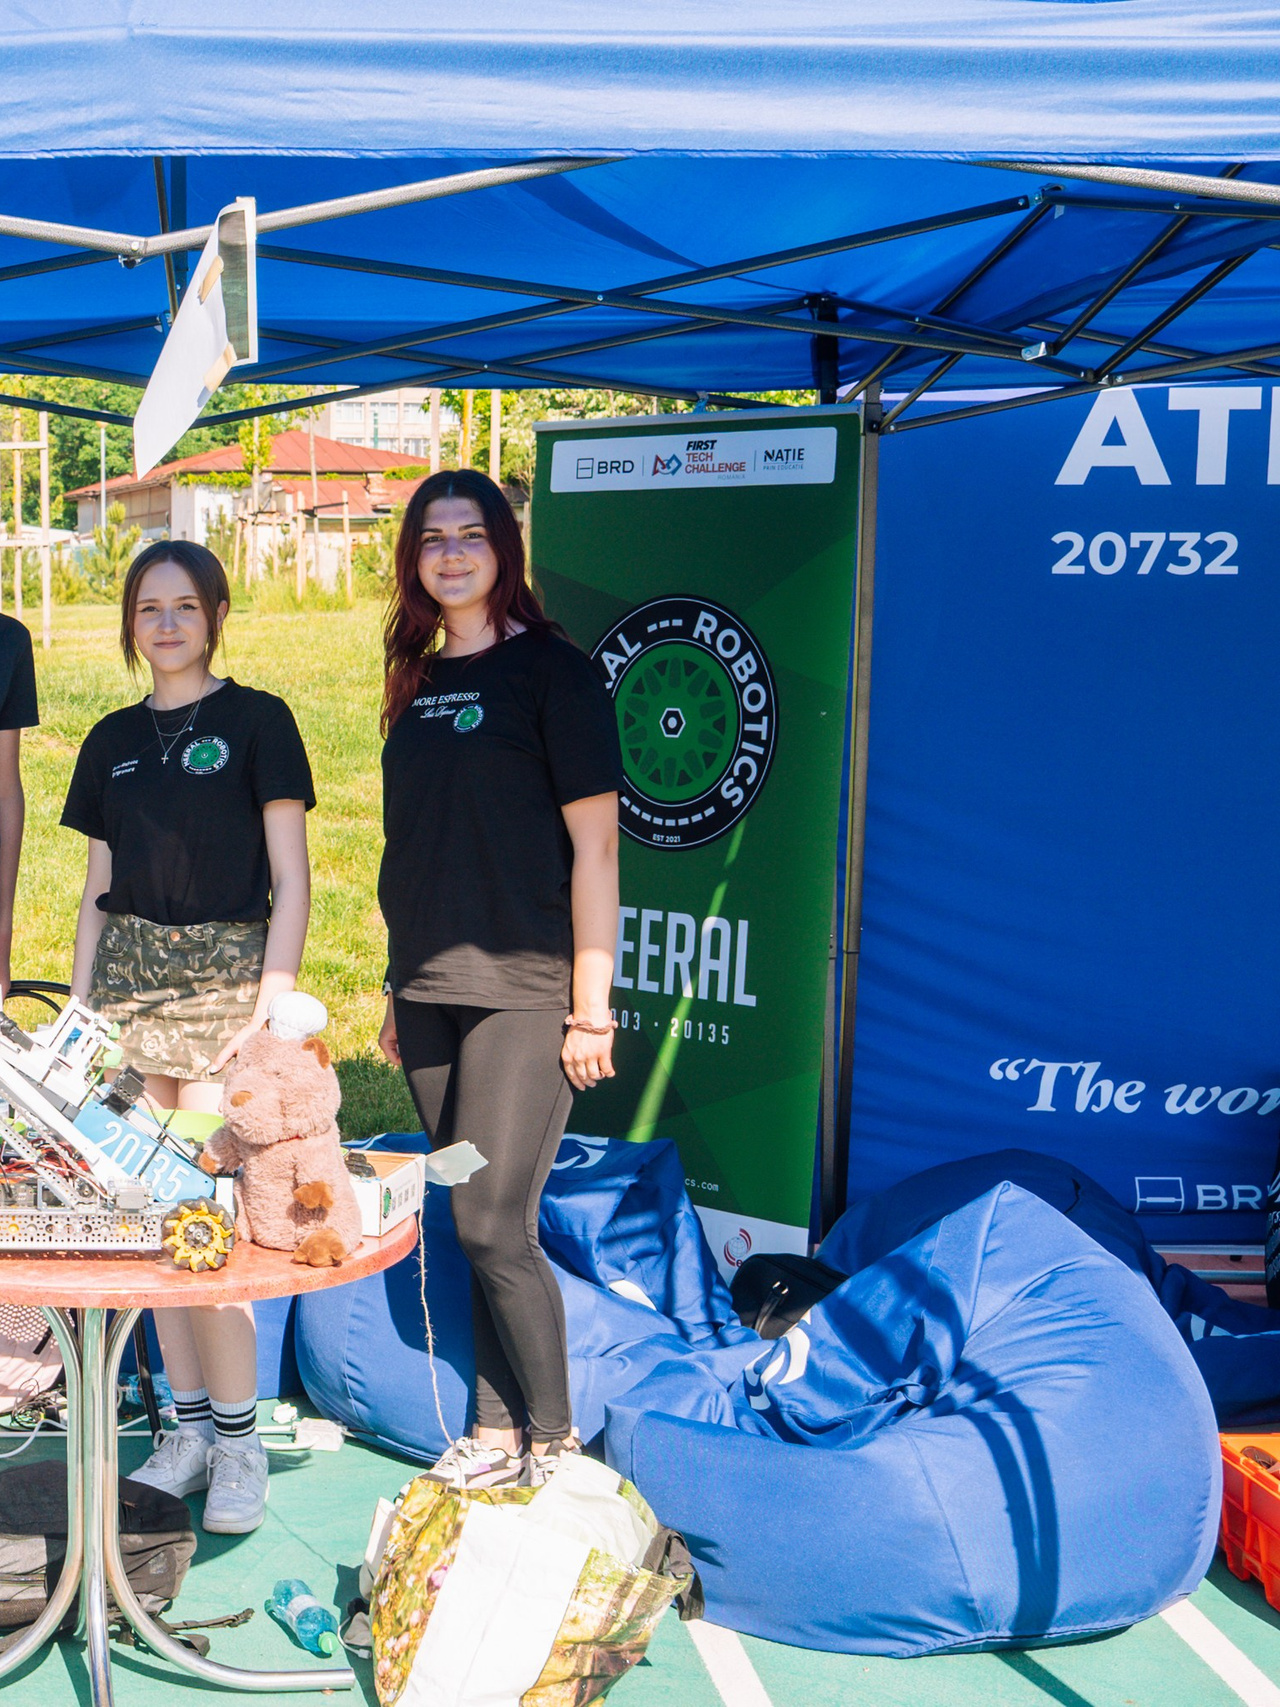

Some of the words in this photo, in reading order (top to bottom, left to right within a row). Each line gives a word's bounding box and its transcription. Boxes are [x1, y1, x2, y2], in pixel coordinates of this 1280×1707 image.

[686, 440, 717, 451] FIRST
[686, 452, 713, 463] TECH
[598, 460, 635, 474] BRD
[685, 462, 746, 474] CHALLENGE
[1051, 531, 1239, 575] 20732
[411, 696, 438, 707] MORE
[437, 692, 480, 704] ESPRESSO
[602, 630, 642, 689] AL
[693, 611, 768, 807] ROBOTICS
[211, 738, 227, 770] ROBOTICS
[652, 833, 664, 842] EST
[665, 835, 681, 843] 2021
[612, 906, 756, 1007] EERAL
[670, 1017, 729, 1044] 20135
[989, 1058, 1146, 1113] “The
[95, 1121, 191, 1202] 20135
[684, 1178, 719, 1192] cs.com
[1196, 1184, 1271, 1210] BR
